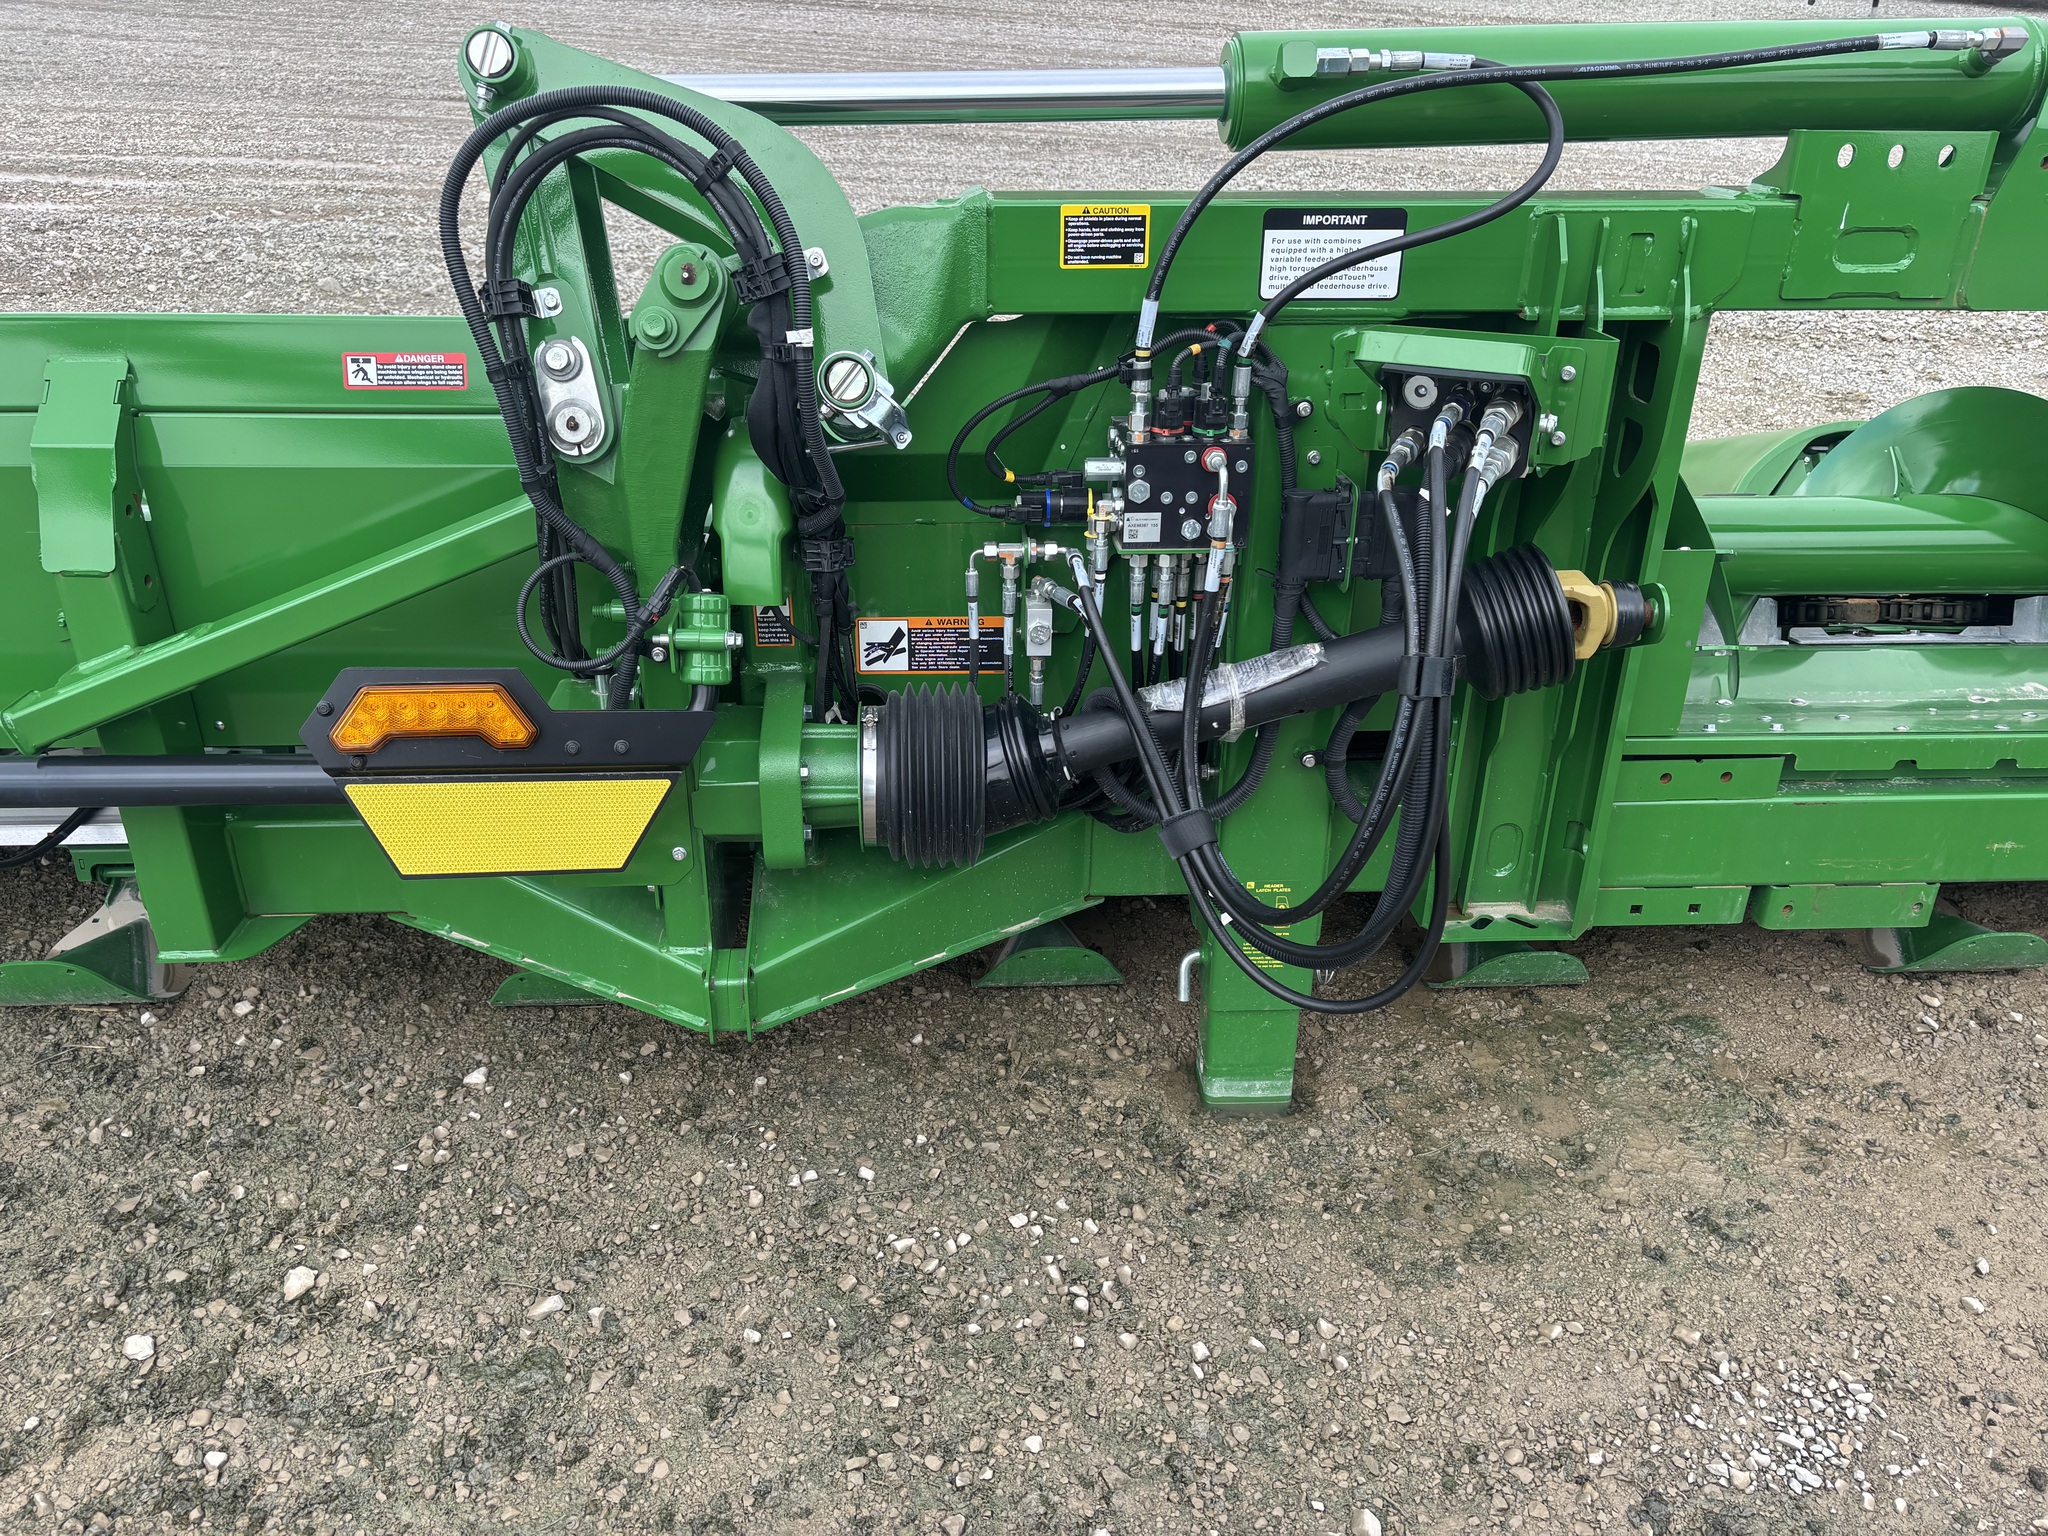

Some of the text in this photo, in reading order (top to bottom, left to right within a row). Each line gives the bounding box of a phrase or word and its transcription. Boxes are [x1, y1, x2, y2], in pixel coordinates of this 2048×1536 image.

[1797, 45, 1822, 54] exceeds
[1274, 120, 1300, 137] exceeds
[1302, 215, 1368, 225] IMPORTANT
[1270, 265, 1286, 273] high
[1387, 752, 1400, 781] exceeds
